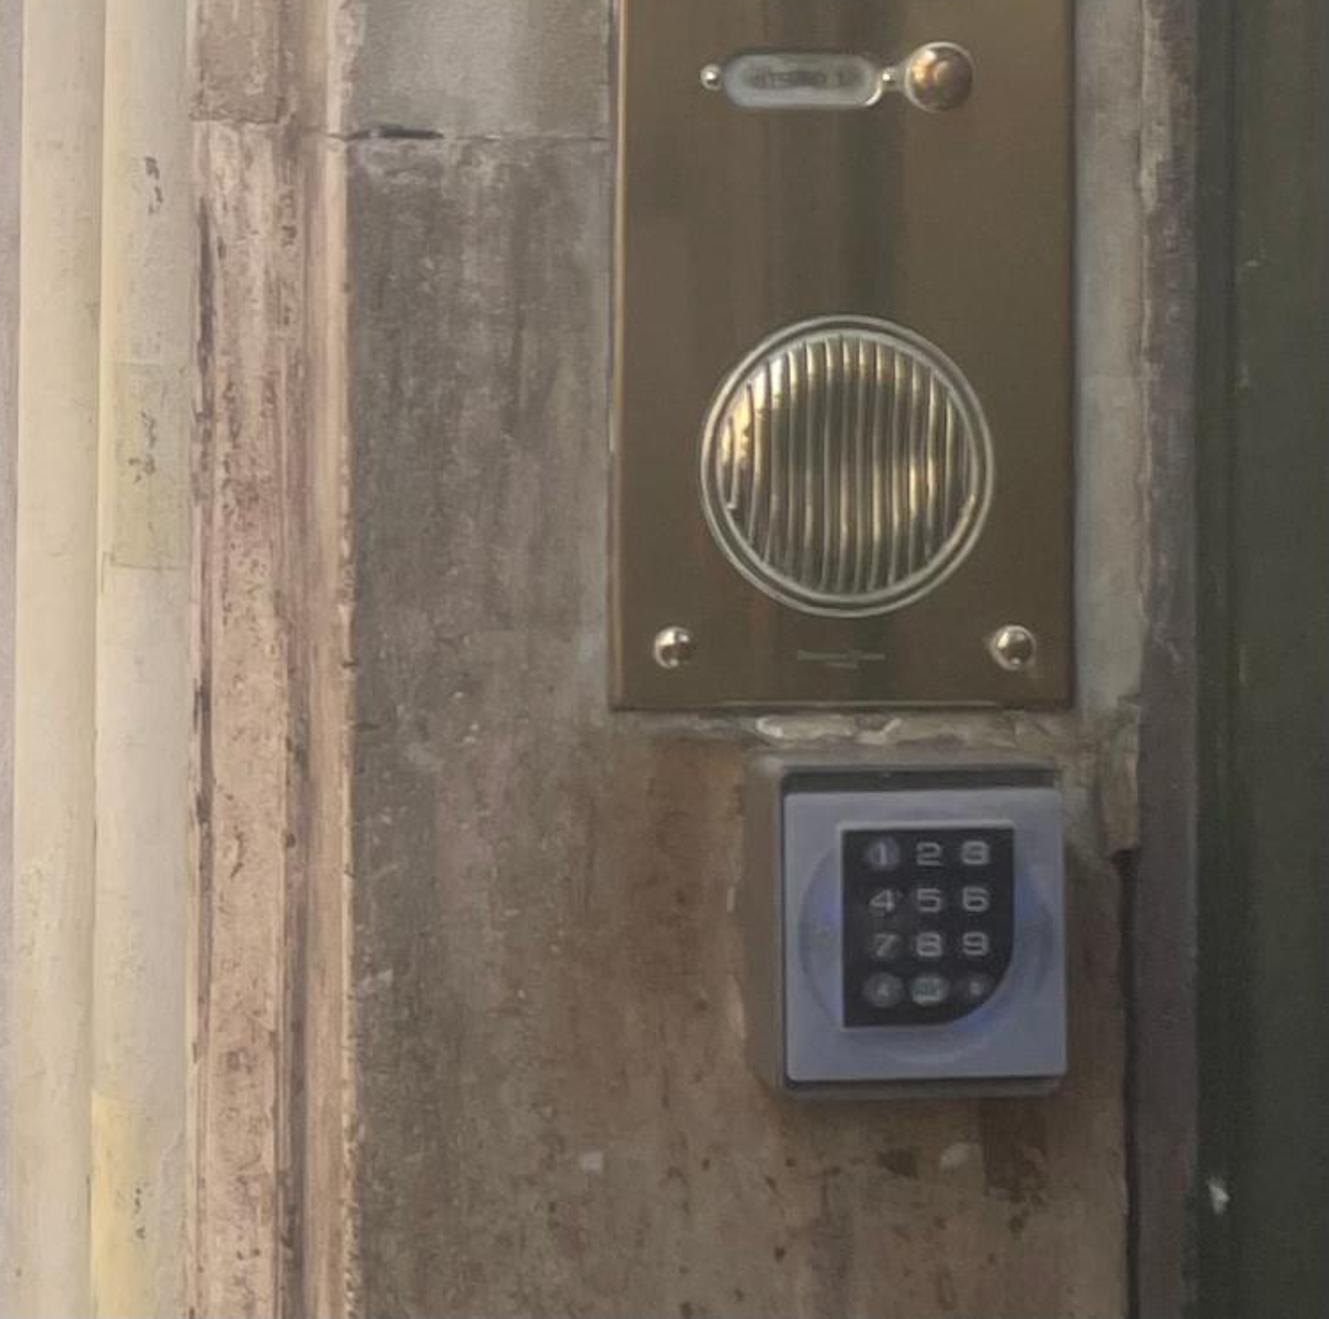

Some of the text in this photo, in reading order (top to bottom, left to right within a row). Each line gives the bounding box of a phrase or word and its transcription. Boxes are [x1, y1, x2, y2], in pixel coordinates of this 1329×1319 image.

[915, 841, 942, 867] 2
[869, 886, 990, 913] 4 5 6
[874, 931, 989, 958] 7 8 9
